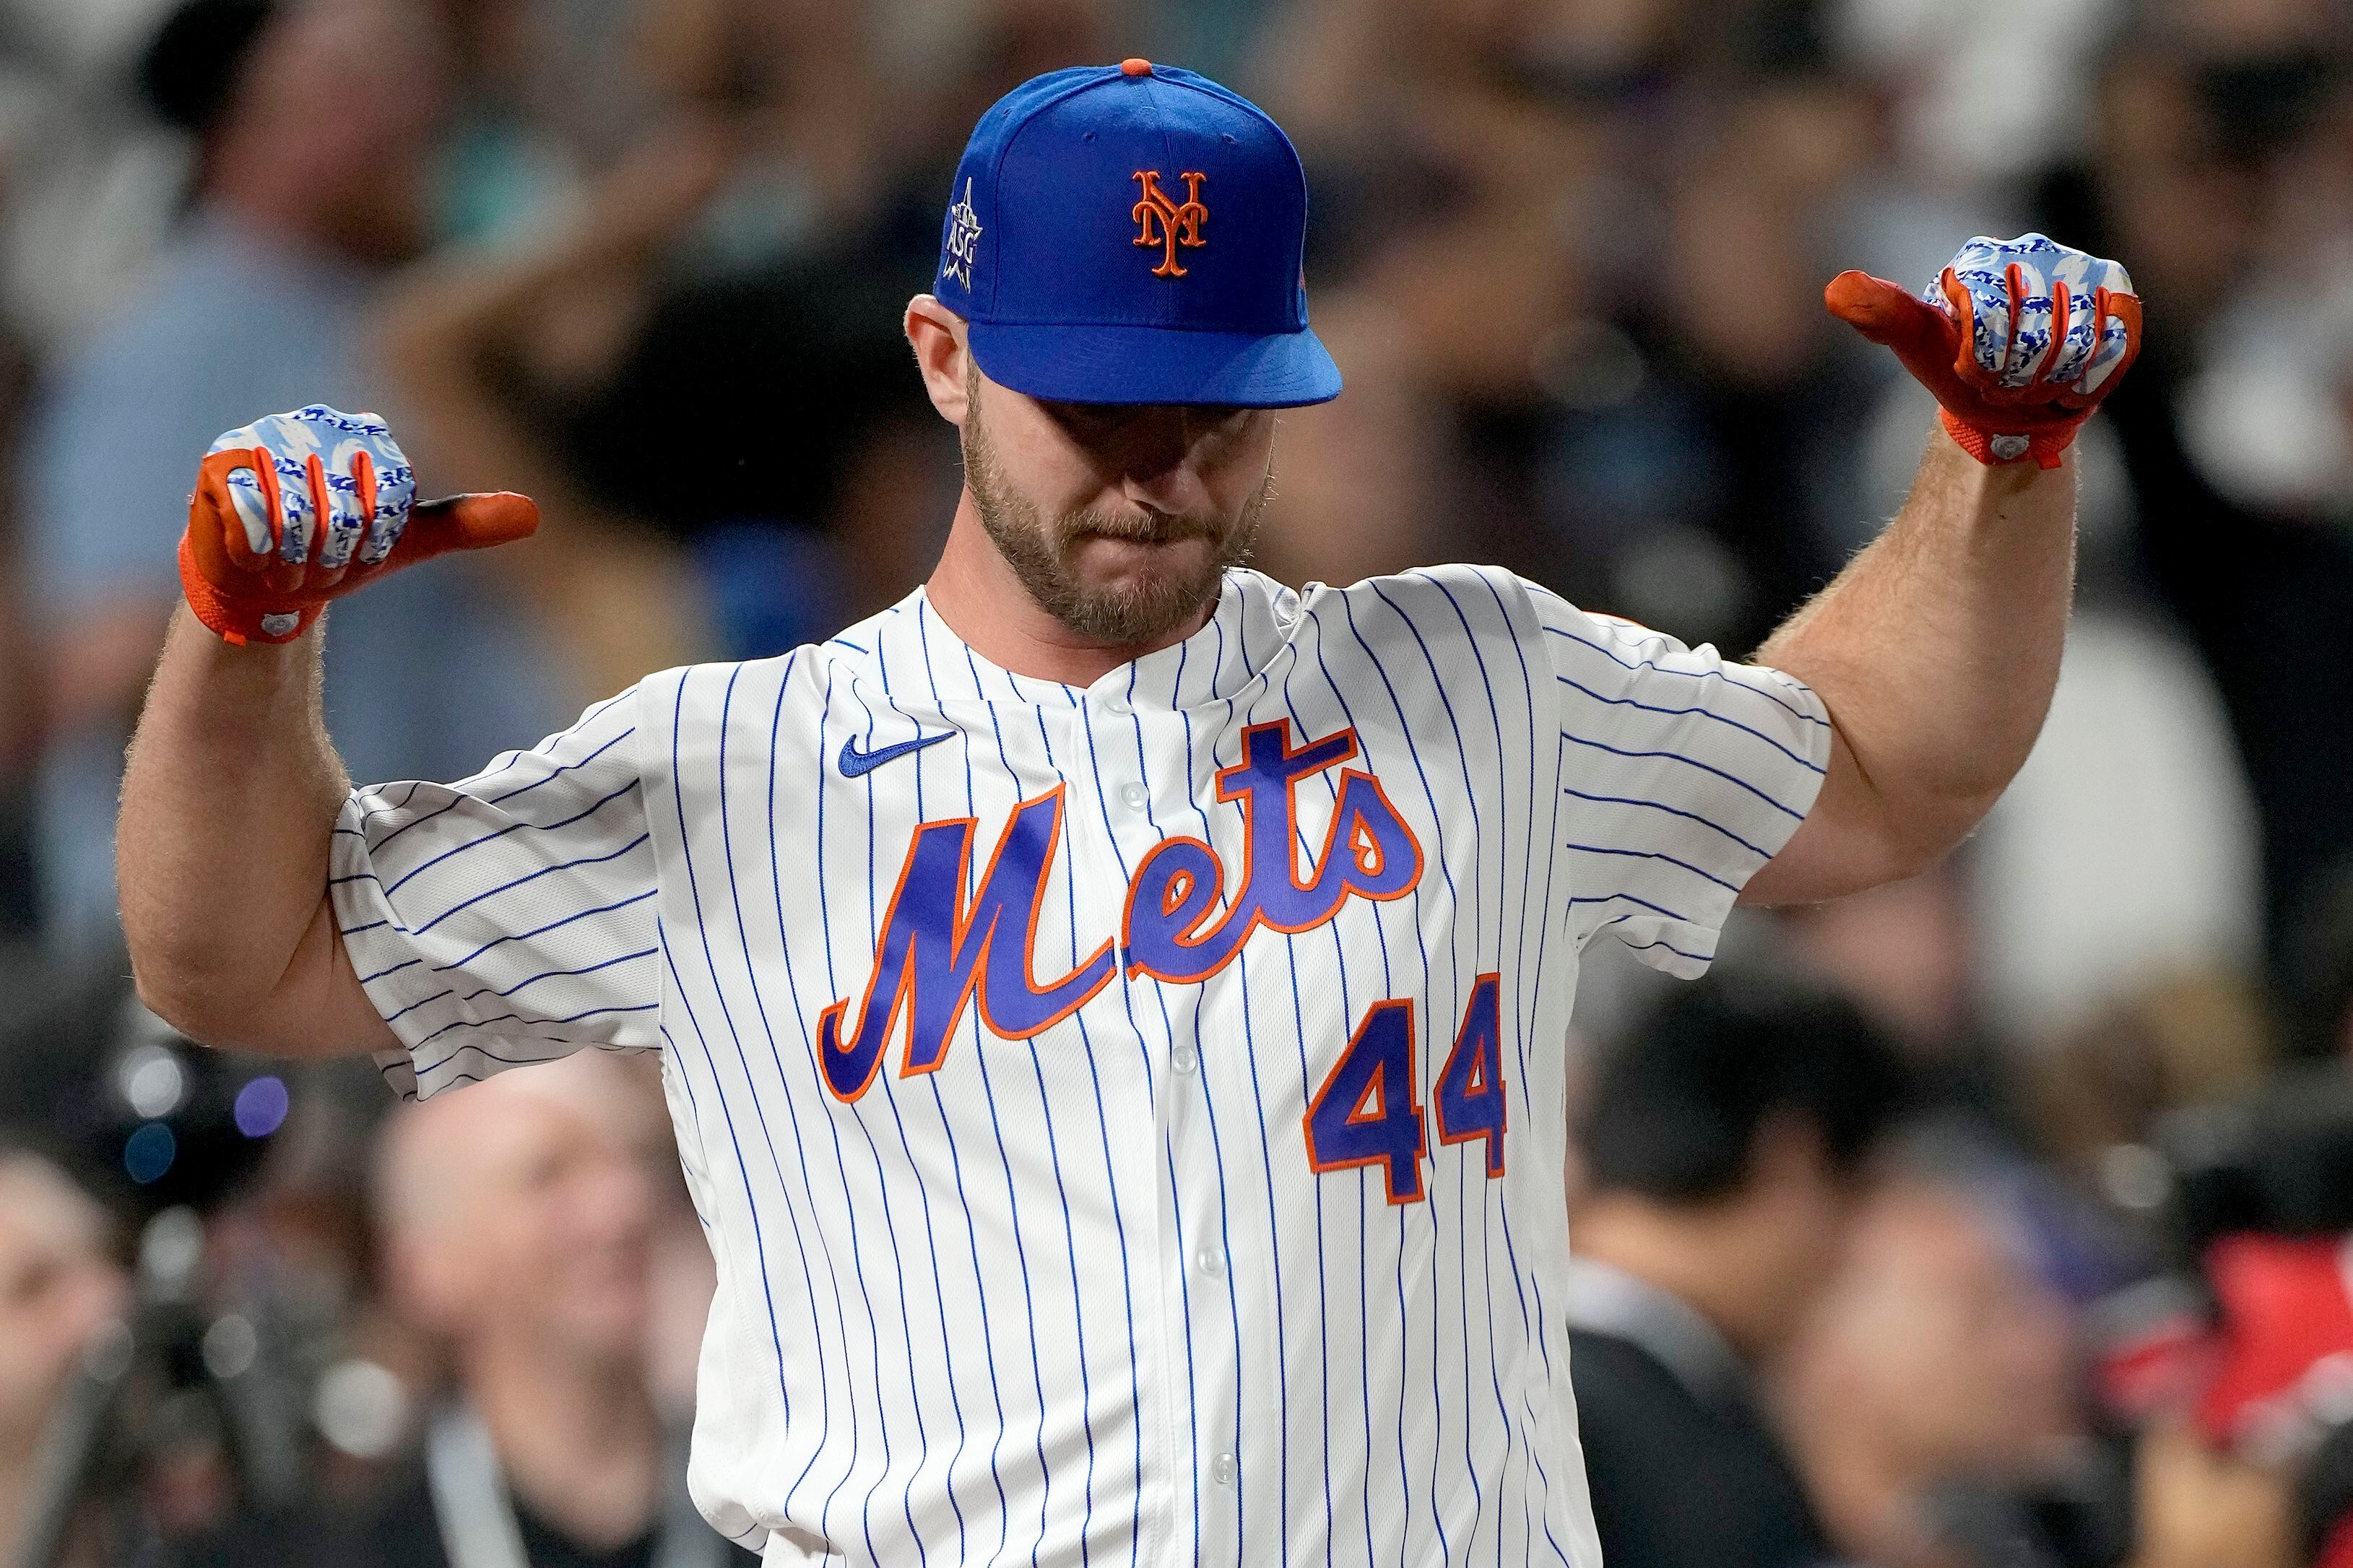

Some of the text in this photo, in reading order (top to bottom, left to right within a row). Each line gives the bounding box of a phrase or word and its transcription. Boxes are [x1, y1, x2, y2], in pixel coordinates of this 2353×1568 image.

[946, 220, 977, 266] ASG
[817, 717, 1424, 1104] Mets
[1302, 972, 1507, 1205] 44
